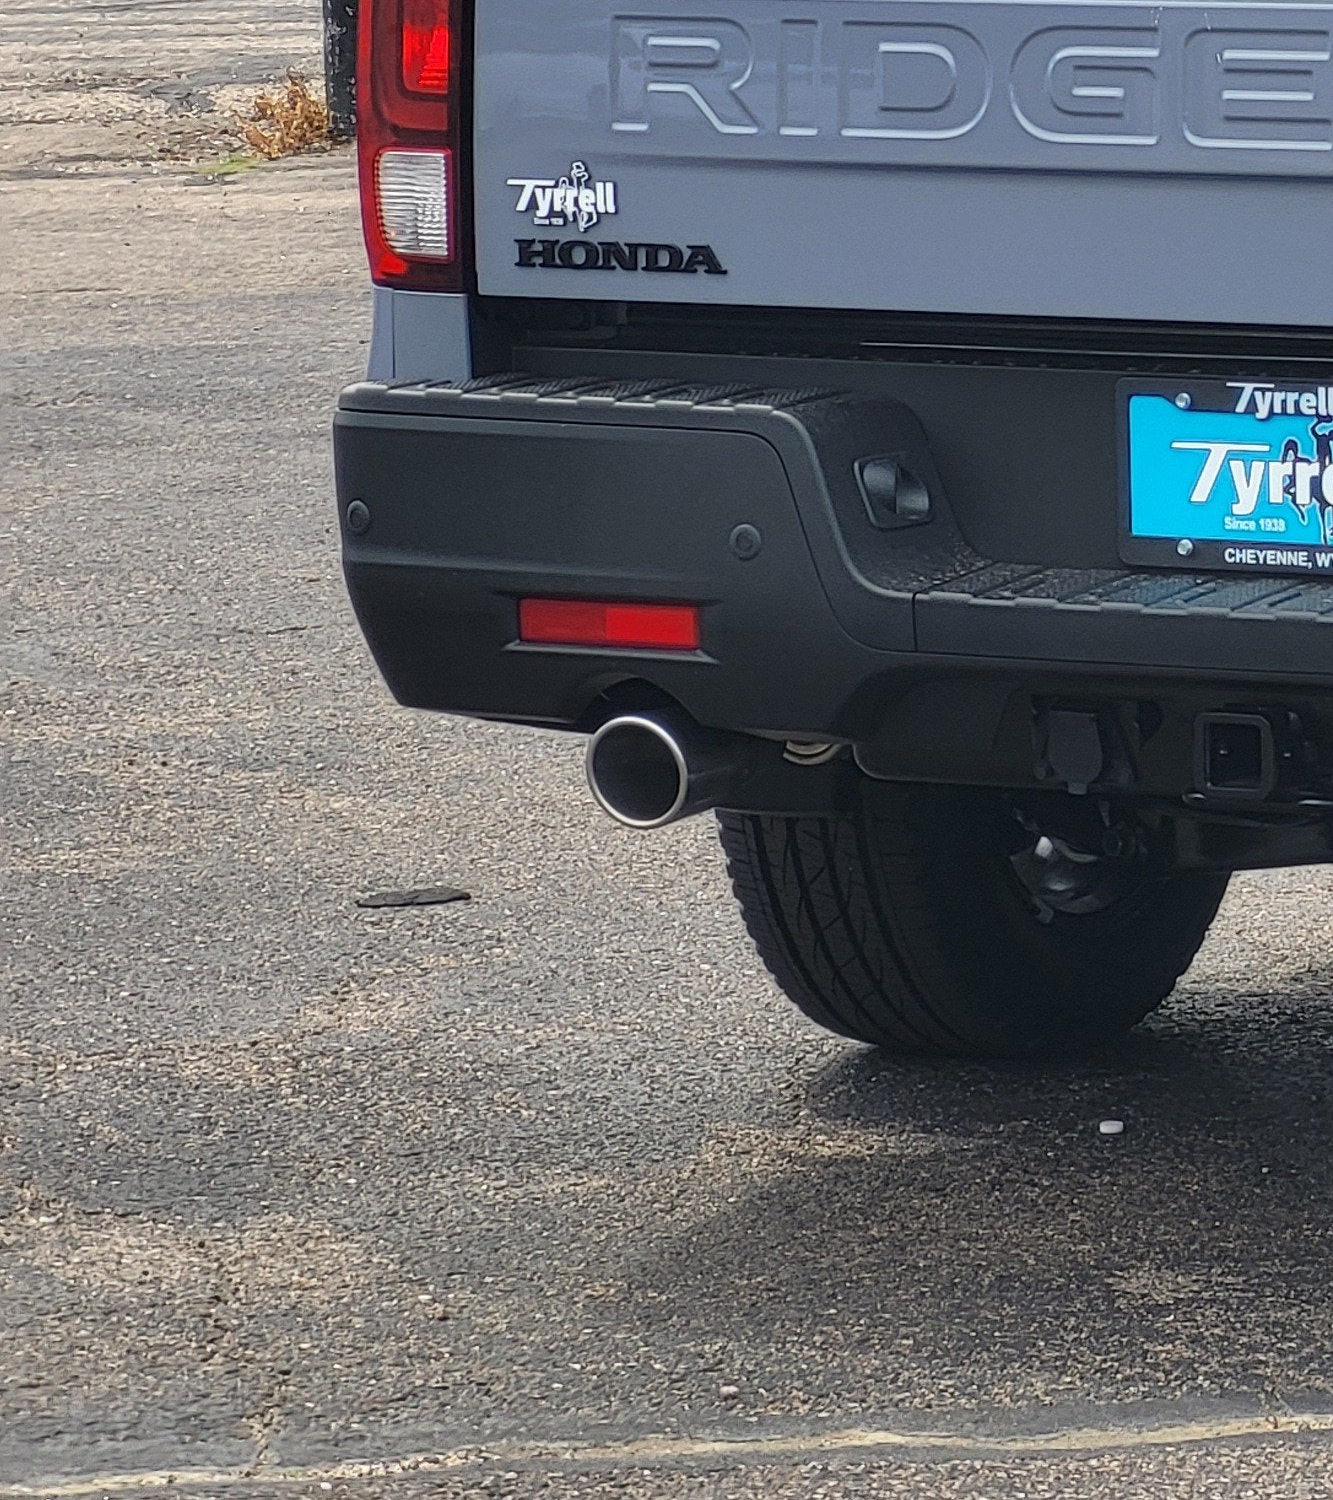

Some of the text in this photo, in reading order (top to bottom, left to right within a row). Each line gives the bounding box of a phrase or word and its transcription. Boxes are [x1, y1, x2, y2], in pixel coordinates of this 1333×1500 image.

[506, 179, 616, 217] Tyrrell
[514, 239, 728, 275] HONDA
[1224, 517, 1287, 532] Since 1938
[1224, 547, 1312, 570] CHEYENNE,
